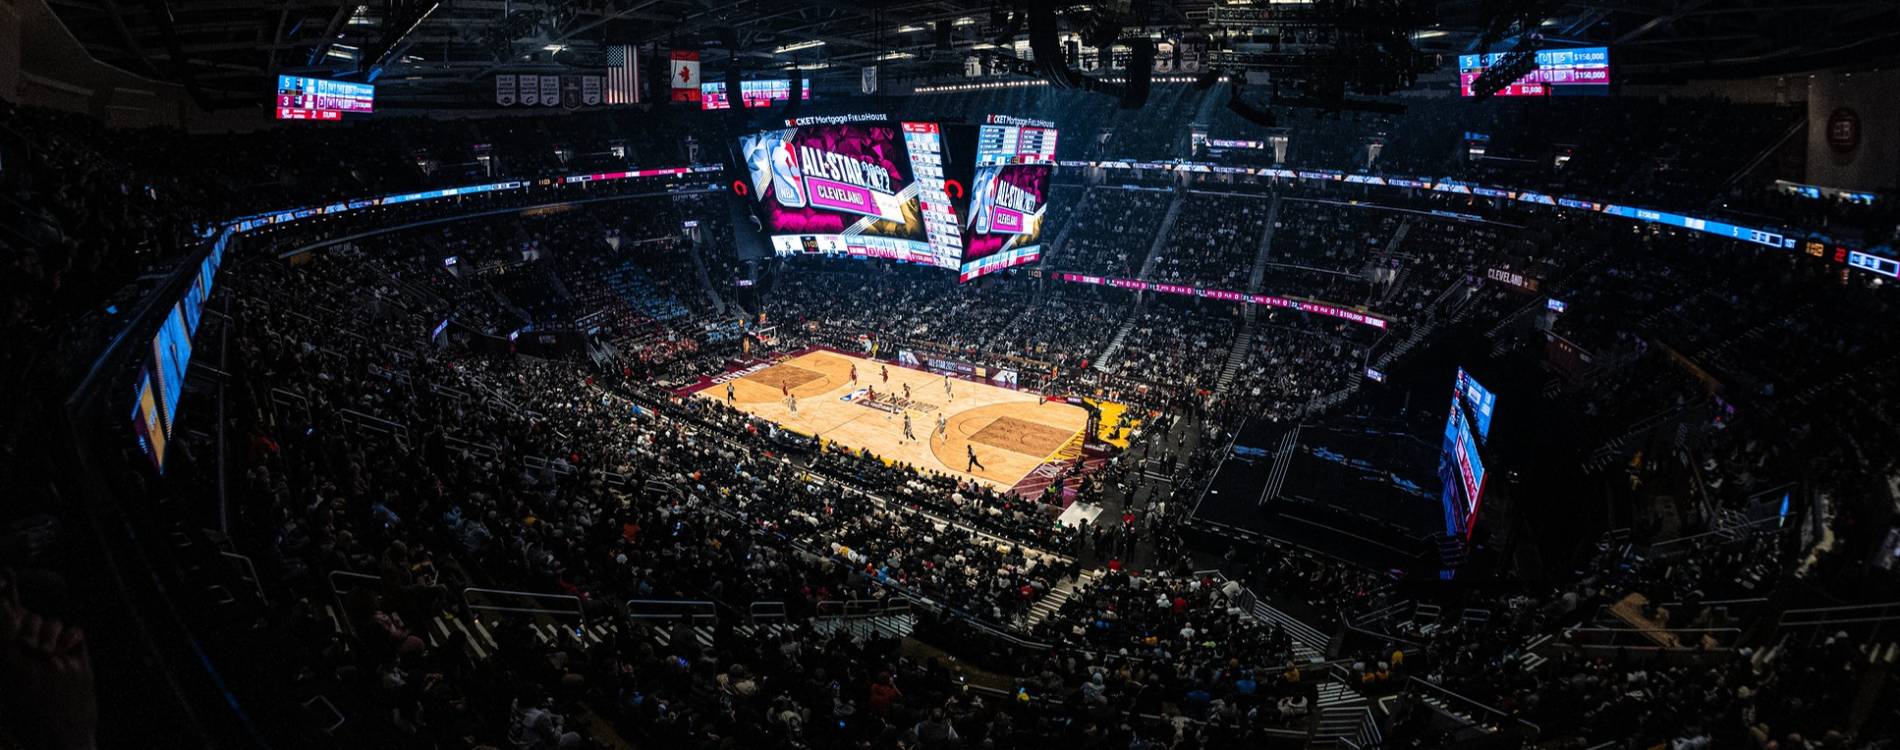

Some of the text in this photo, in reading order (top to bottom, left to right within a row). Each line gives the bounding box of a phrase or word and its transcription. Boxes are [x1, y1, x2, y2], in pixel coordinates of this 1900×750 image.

[1467, 56, 1472, 66] 5
[1574, 53, 1604, 61] $150,000
[1468, 74, 1474, 84] 3
[1575, 72, 1606, 80] $150,000
[285, 78, 290, 88] 5
[1506, 86, 1512, 95] 2
[284, 96, 289, 106] 3
[312, 110, 317, 118] 2
[785, 117, 814, 127] ROCKET
[815, 114, 848, 125] Mortgage
[986, 114, 1006, 124] ROCKET
[1006, 116, 1028, 127] Mortgage
[930, 124, 936, 133] 2
[817, 180, 865, 206] CLEVELAND
[1733, 226, 1738, 237] 5
[785, 240, 791, 249] 5
[830, 241, 836, 249] 3
[1488, 268, 1523, 287] CLEVELAND
[1340, 310, 1363, 321] $150,000
